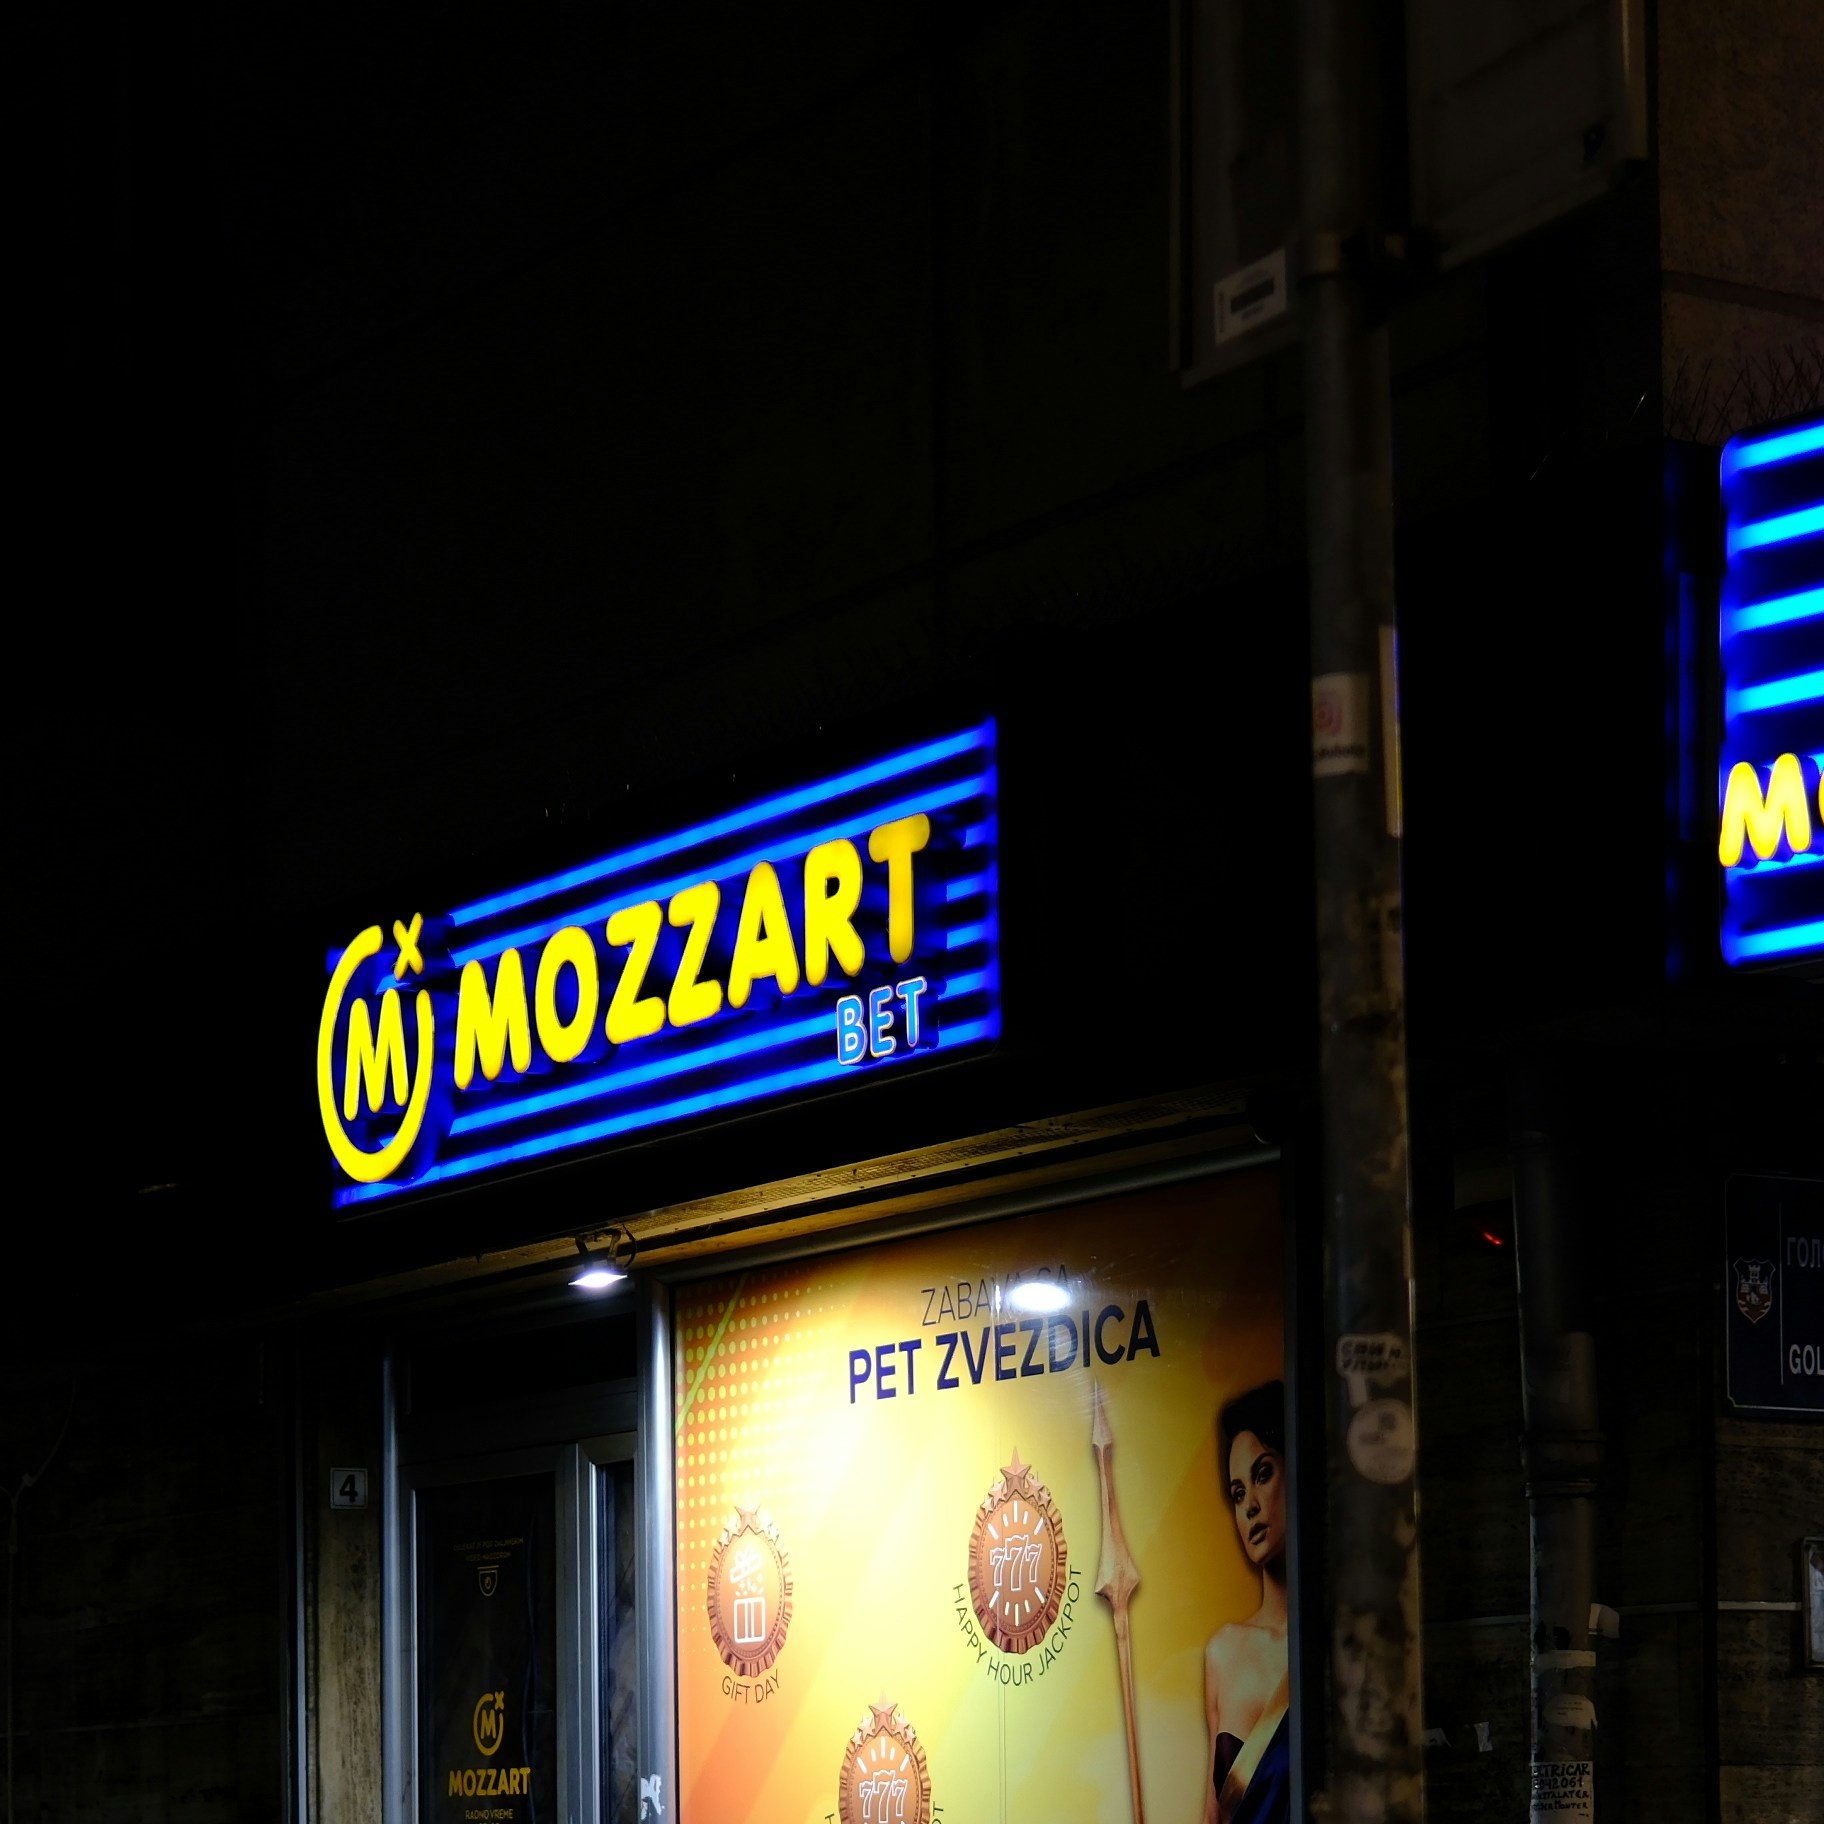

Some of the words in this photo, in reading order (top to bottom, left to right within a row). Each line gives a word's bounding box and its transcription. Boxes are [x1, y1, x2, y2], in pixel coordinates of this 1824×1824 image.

[454, 812, 931, 1091] MOZZART
[836, 975, 928, 1067] BET
[921, 1272, 1025, 1327] ZABA
[849, 1338, 921, 1404] PET
[936, 1300, 1161, 1391] ZVEZDICA
[340, 1474, 358, 1502] 4
[952, 1583, 987, 1664] HAPPY
[987, 1659, 1034, 1687] HOUR
[1038, 1564, 1082, 1676] JACKPOT
[721, 1675, 751, 1704] GIFT
[755, 1669, 780, 1702] DAY
[448, 1766, 531, 1797] MOZZART
